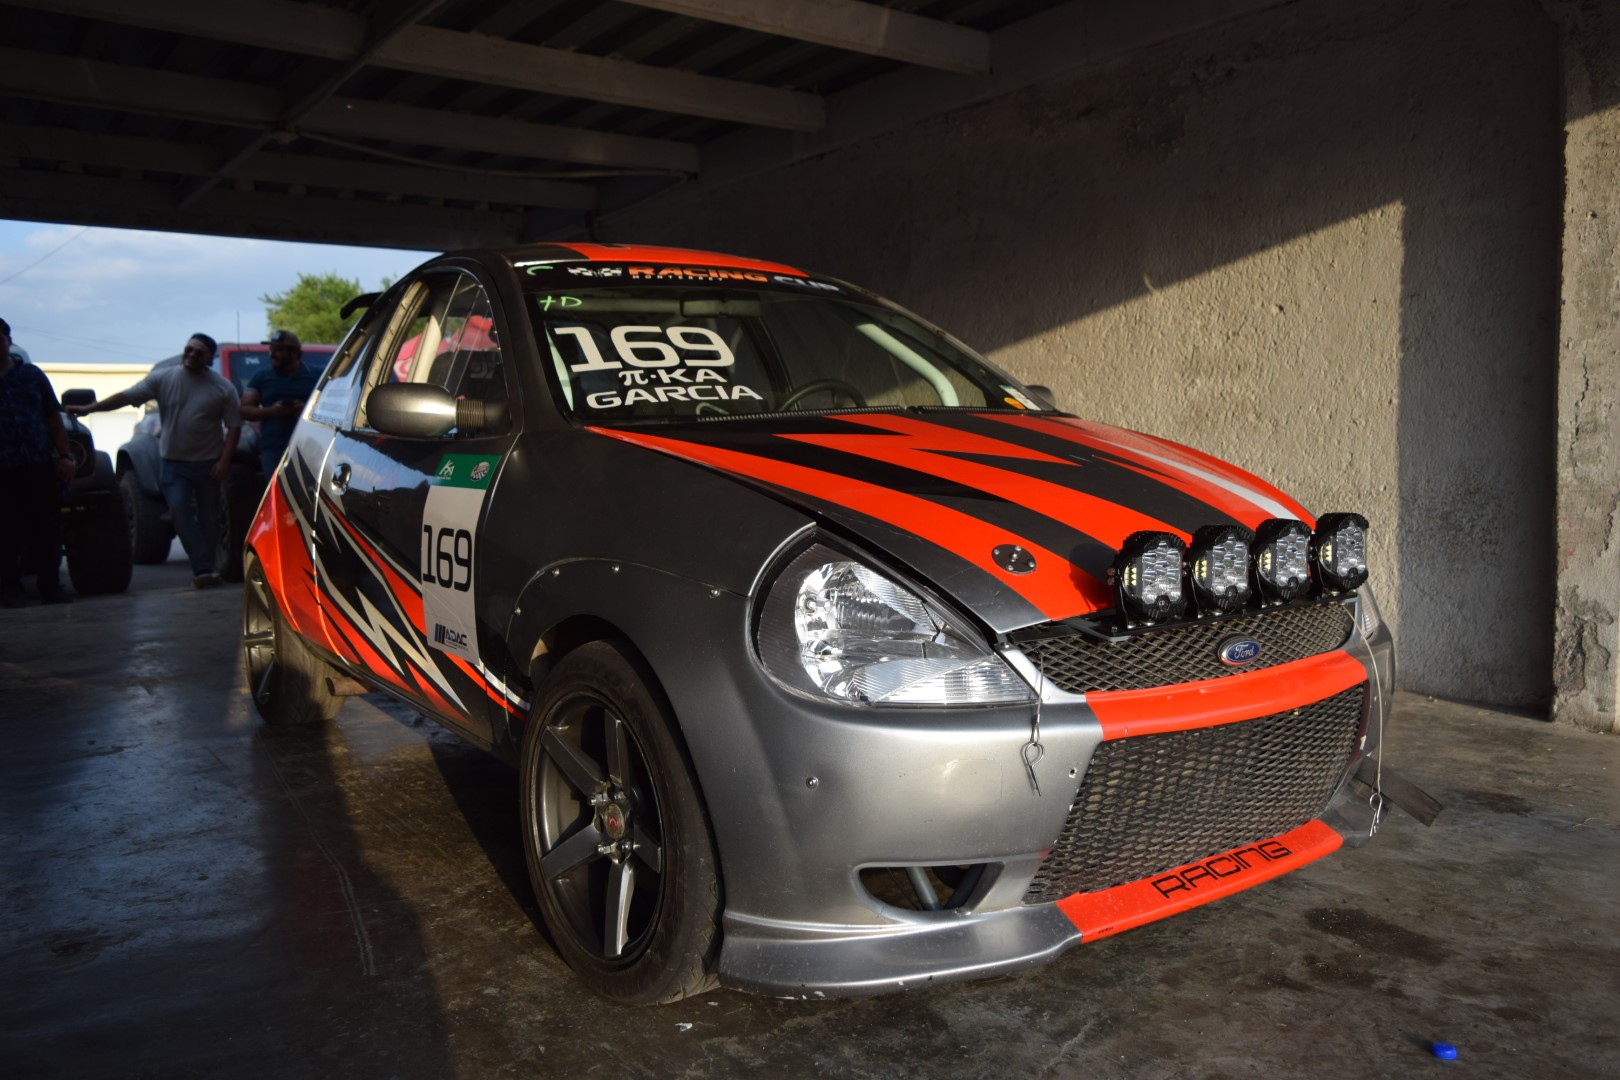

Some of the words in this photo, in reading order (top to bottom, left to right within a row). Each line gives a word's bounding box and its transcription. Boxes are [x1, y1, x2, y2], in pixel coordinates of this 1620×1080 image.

[628, 266, 768, 283] RACING
[553, 325, 735, 373] 169
[586, 385, 764, 410] GARCIA
[423, 524, 472, 592] 169
[1234, 643, 1256, 659] Ford
[1151, 841, 1292, 898] RACING
